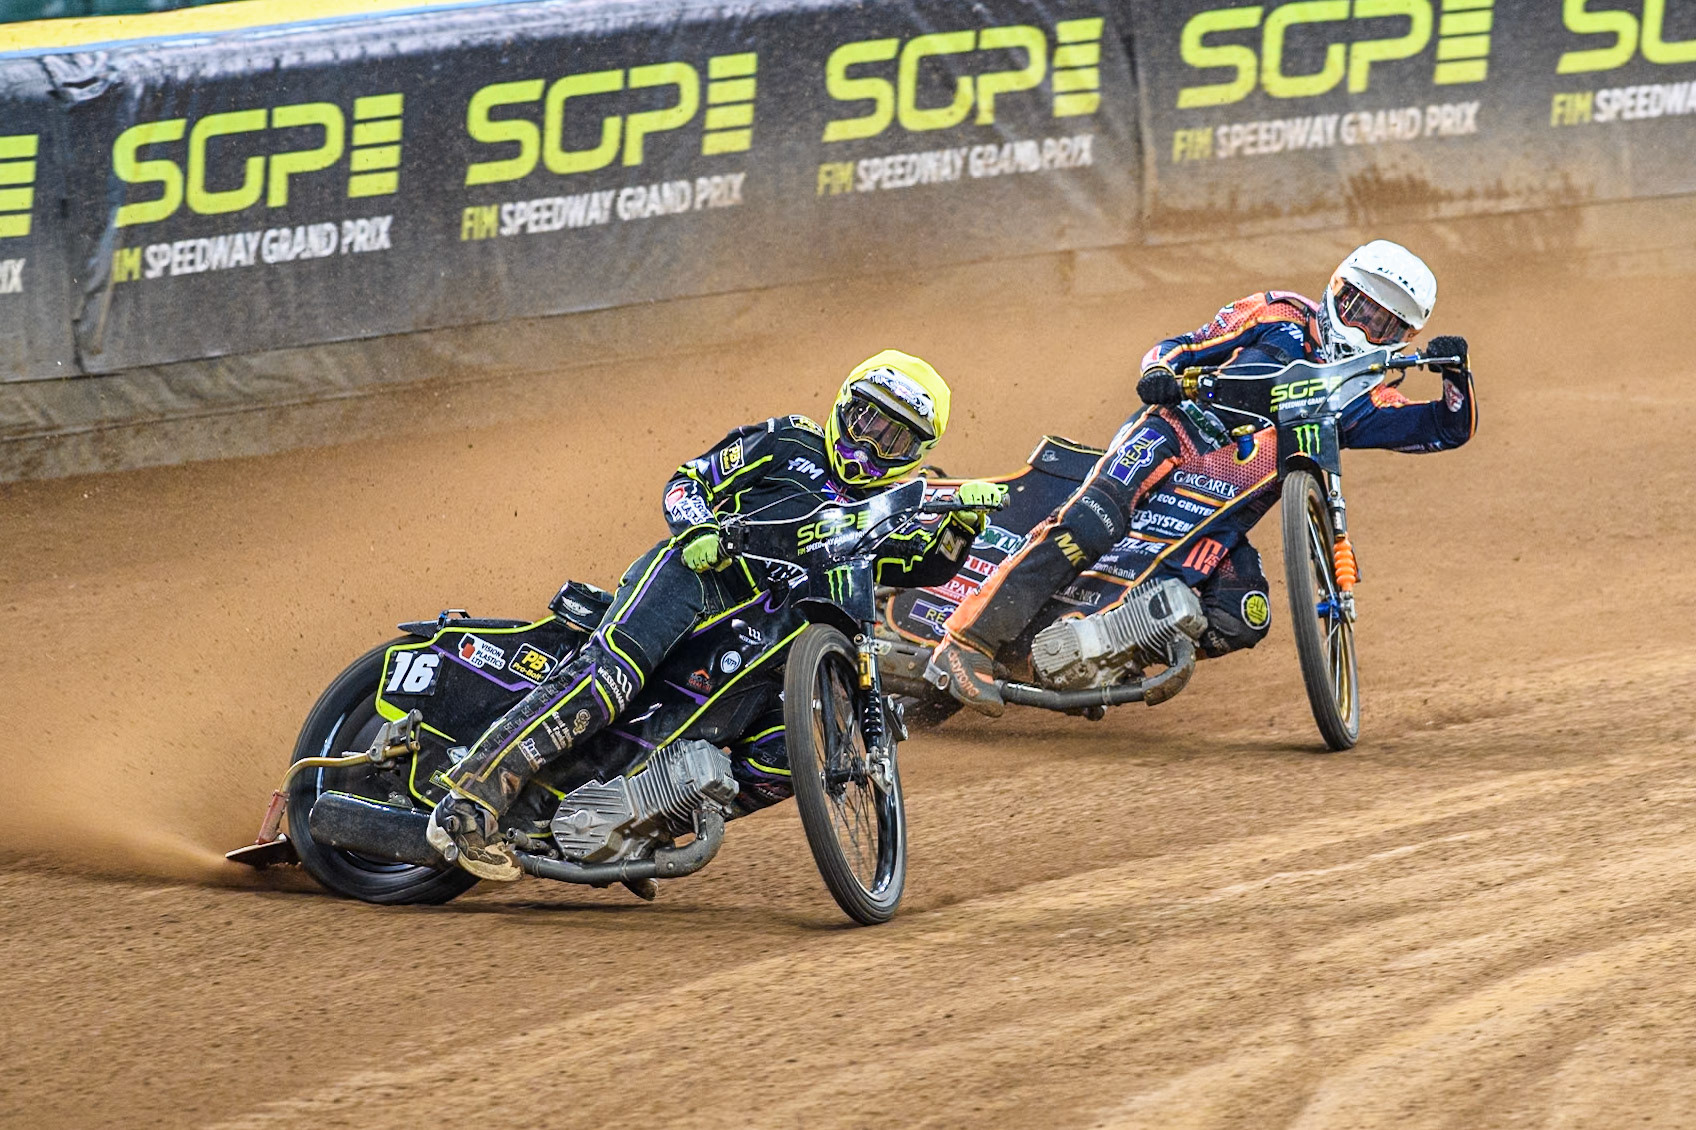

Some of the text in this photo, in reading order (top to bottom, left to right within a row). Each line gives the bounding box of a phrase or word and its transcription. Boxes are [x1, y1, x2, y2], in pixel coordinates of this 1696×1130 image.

[822, 25, 1048, 143] SGP
[466, 61, 698, 186] SGP
[1551, 91, 1594, 127] FIM
[1173, 101, 1481, 163] FIM SPEEDWAY GRAND PRIX
[113, 102, 345, 228] SGP
[817, 133, 1095, 196] FIM SPEEDWAY GRAND PRIX
[460, 172, 746, 241] FIM SPEEDWAY GRAND PRIX
[113, 214, 394, 284] IM SPEEDWAY GRAND PRIX
[787, 456, 825, 480] FIM
[1156, 493, 1177, 506] ECO
[471, 656, 483, 666] LTD
[475, 650, 503, 668] PLASTICS
[481, 642, 503, 658] VISION
[521, 649, 548, 672] PB
[385, 651, 440, 692] 16
[512, 661, 541, 681] Pro-Bolt
